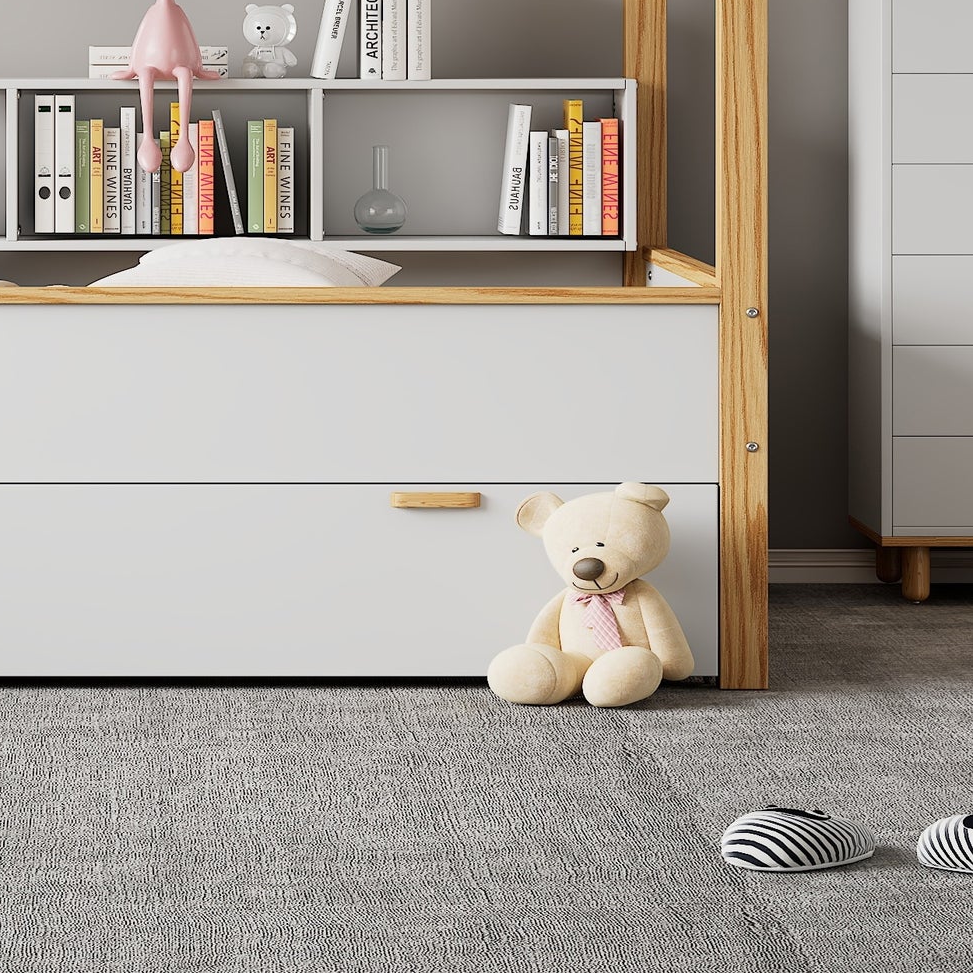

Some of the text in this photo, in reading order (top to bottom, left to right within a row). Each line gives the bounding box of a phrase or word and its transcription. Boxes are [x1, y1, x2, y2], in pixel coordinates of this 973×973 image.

[331, 17, 341, 39] BREUER
[93, 146, 101, 164] ART
[106, 143, 117, 170] FINE
[266, 146, 275, 164] ART
[280, 143, 291, 170] FINE
[106, 177, 117, 219] WINES
[280, 177, 291, 219] WINES
